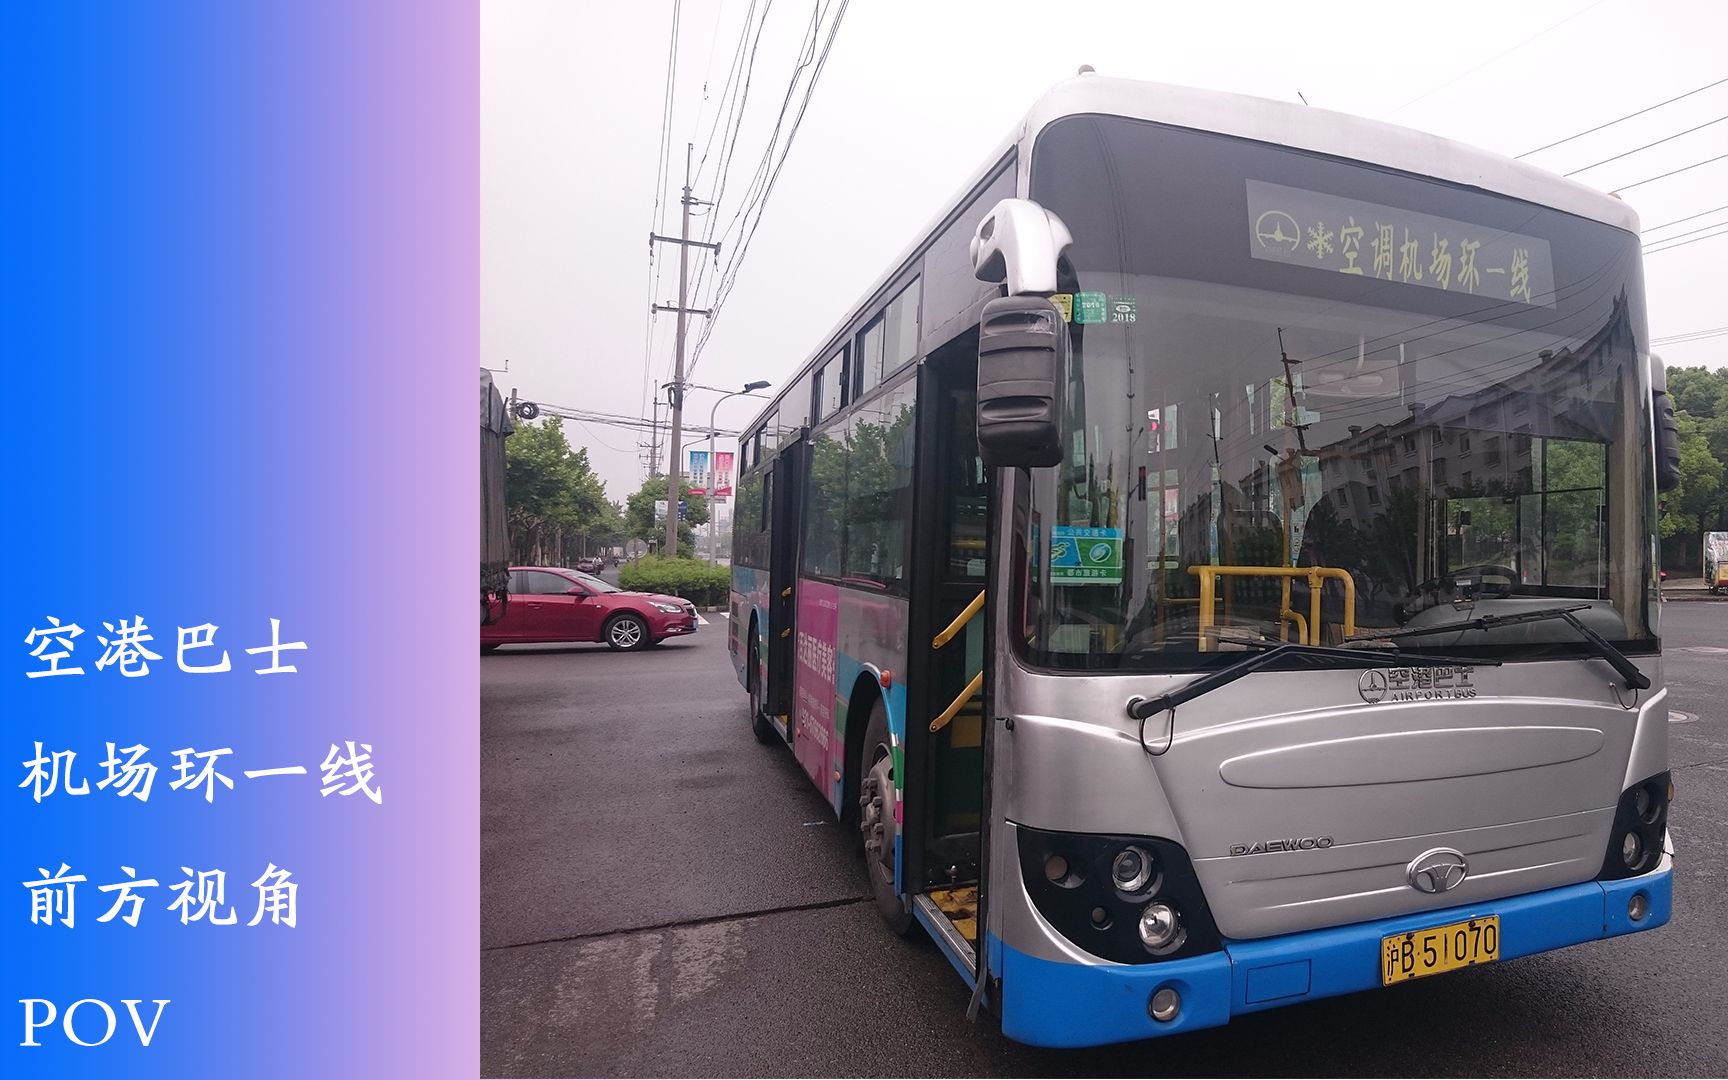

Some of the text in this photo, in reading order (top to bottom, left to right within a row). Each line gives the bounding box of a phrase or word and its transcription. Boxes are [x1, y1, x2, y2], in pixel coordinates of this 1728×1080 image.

[1340, 216, 1531, 304] 空调机场环一线
[1112, 313, 1136, 322] 2018
[1067, 528, 1108, 537] 公共交通卡
[1067, 569, 1107, 577] 都市旅游卡
[1387, 666, 1475, 691] 空港巴士
[1229, 836, 1334, 857] DAEWOO
